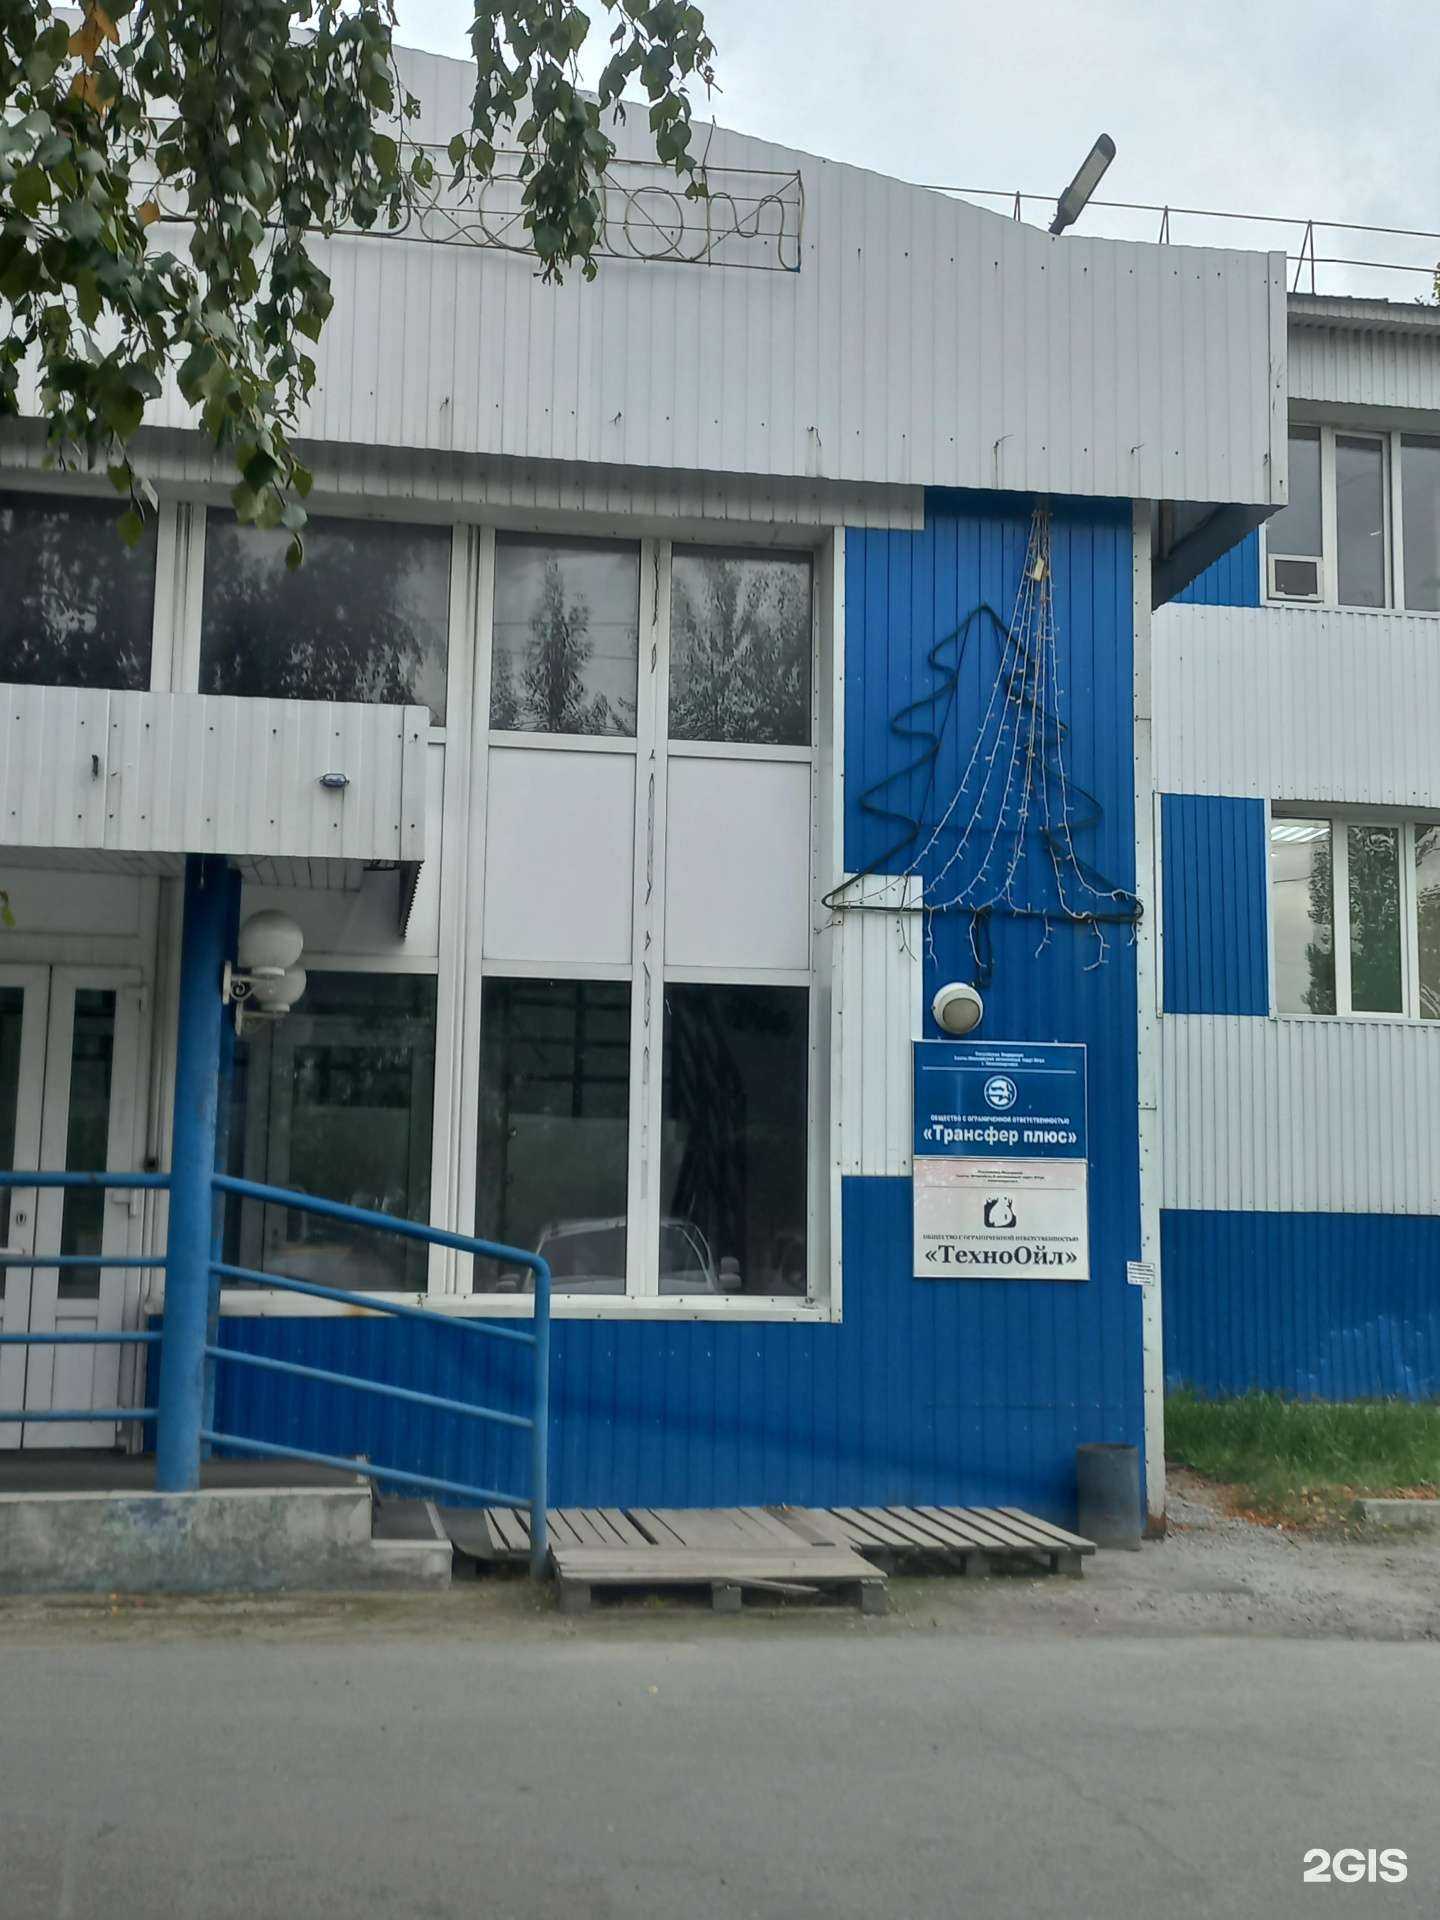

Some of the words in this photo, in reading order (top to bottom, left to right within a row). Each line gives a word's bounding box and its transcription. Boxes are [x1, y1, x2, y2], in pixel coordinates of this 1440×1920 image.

[930, 1114, 961, 1123] ОБЩЕСТВО
[967, 1115, 1012, 1123] ОГРАНИЧЕННОЙ
[1012, 1116, 1070, 1125] ОТВЕТСТВЕННОСТЬЮ
[923, 1124, 1018, 1145] «Трансфер
[1023, 1130, 1077, 1144] плюс»
[925, 1244, 1078, 1266] «ТехноОйл»
